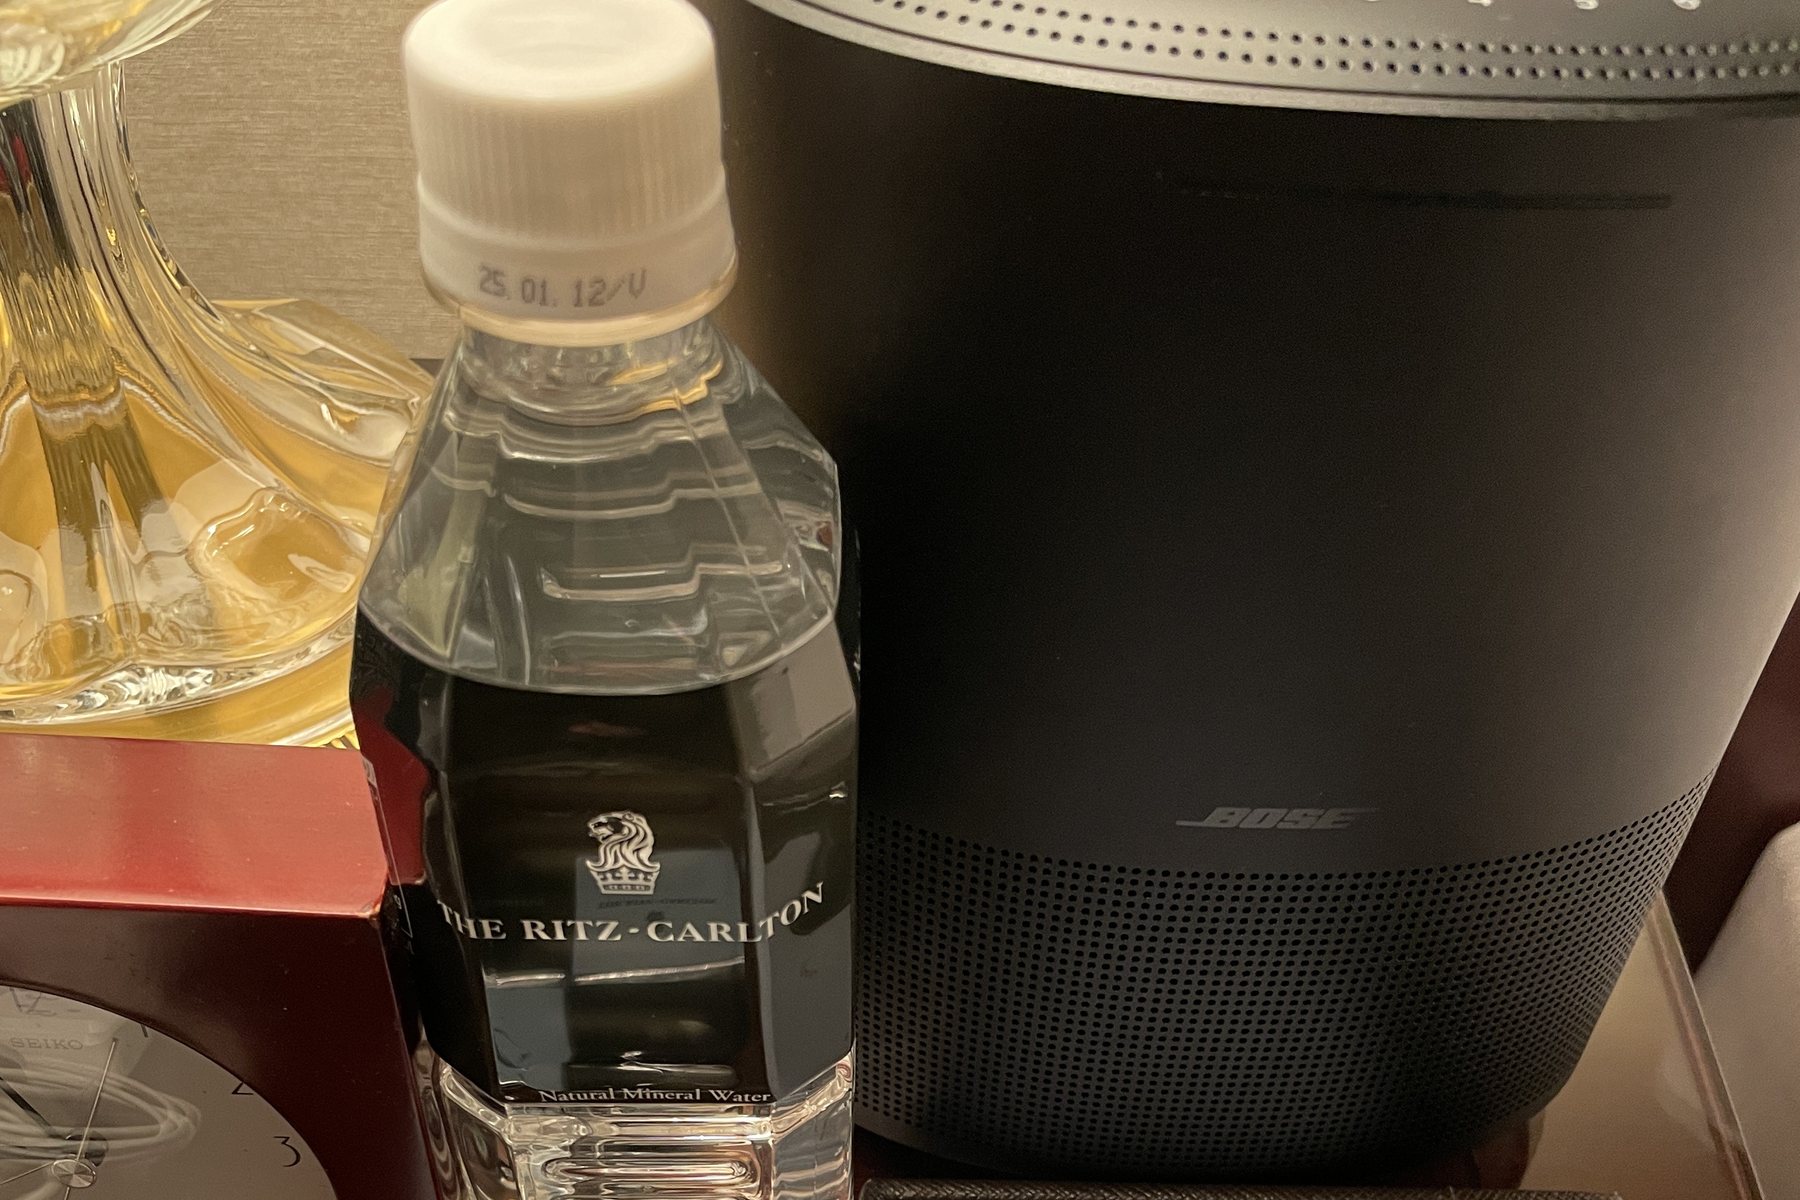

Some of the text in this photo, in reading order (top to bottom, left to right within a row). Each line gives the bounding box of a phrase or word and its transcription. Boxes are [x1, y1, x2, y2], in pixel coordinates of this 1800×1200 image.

[1175, 806, 1378, 830] BOSE
[437, 880, 824, 943] THE RITZ-CARLTON
[10, 1037, 84, 1050] SEIKO
[539, 1088, 771, 1102] Natural Mineral Water
[273, 1136, 301, 1167] 3
